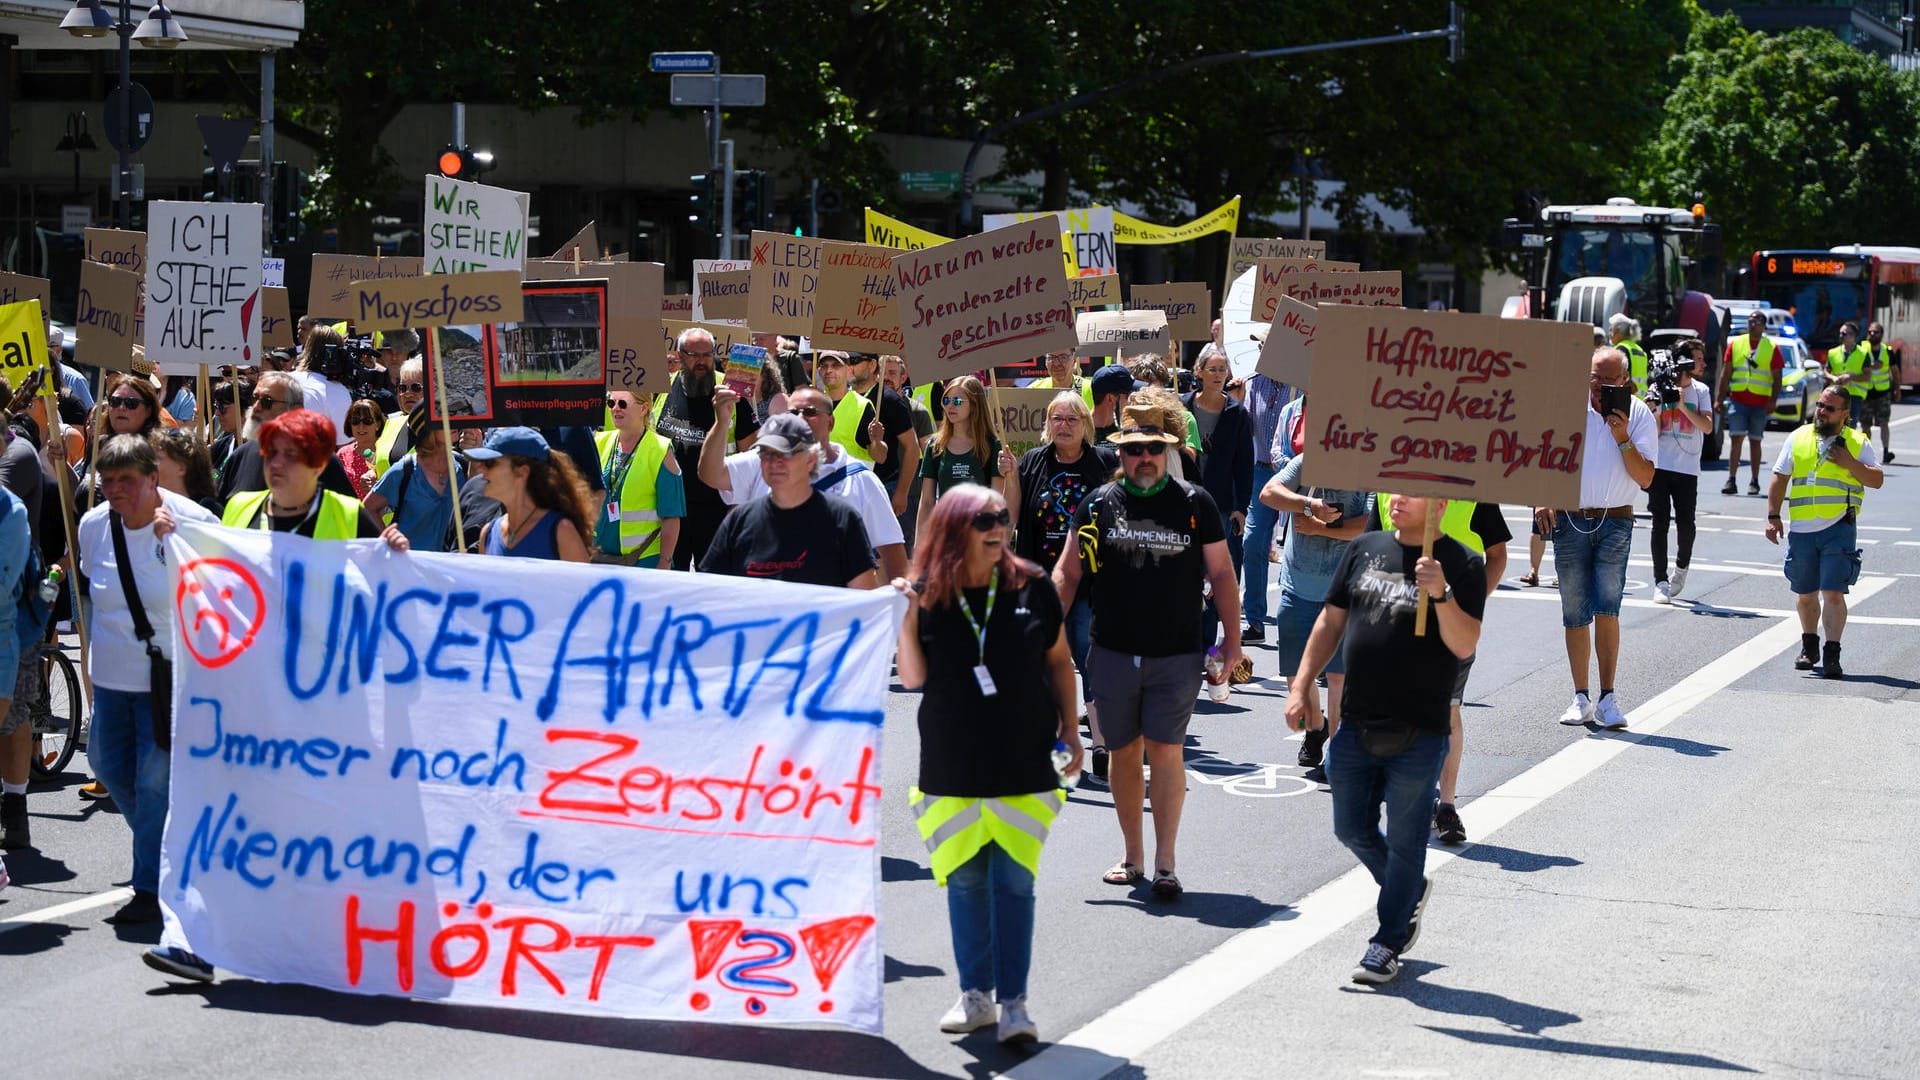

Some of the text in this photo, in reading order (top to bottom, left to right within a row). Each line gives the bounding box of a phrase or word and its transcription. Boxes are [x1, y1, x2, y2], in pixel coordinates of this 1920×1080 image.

[171, 214, 229, 256] ICH
[430, 223, 521, 260] STEHEN
[1113, 221, 1136, 240] gen
[772, 241, 820, 269] LEBE
[827, 251, 892, 270] unbürok
[897, 230, 1054, 291] Warum werden
[1076, 232, 1114, 268] ERN
[1234, 242, 1264, 257] WAS
[1267, 244, 1295, 258] MAN
[1767, 257, 1777, 274] 6
[151, 261, 248, 306] STEHE
[702, 275, 751, 298] Altena
[773, 271, 818, 293] IN DI
[1066, 281, 1108, 304] thal
[78, 288, 129, 337] Dernau
[912, 274, 1047, 329] Spendenzelte
[0, 331, 33, 370] al
[822, 318, 904, 348] Erbsenzä
[609, 349, 637, 369] ER
[1365, 326, 1527, 383] Hoffnungs-
[1106, 528, 1191, 545] ZUSAMMENHELD
[284, 560, 884, 724] UNSER AHRTAL
[390, 718, 525, 792] noch
[538, 728, 882, 825] Zerstört
[508, 832, 616, 902] der
[674, 869, 810, 918] uns
[345, 894, 655, 1002] HÖRT
